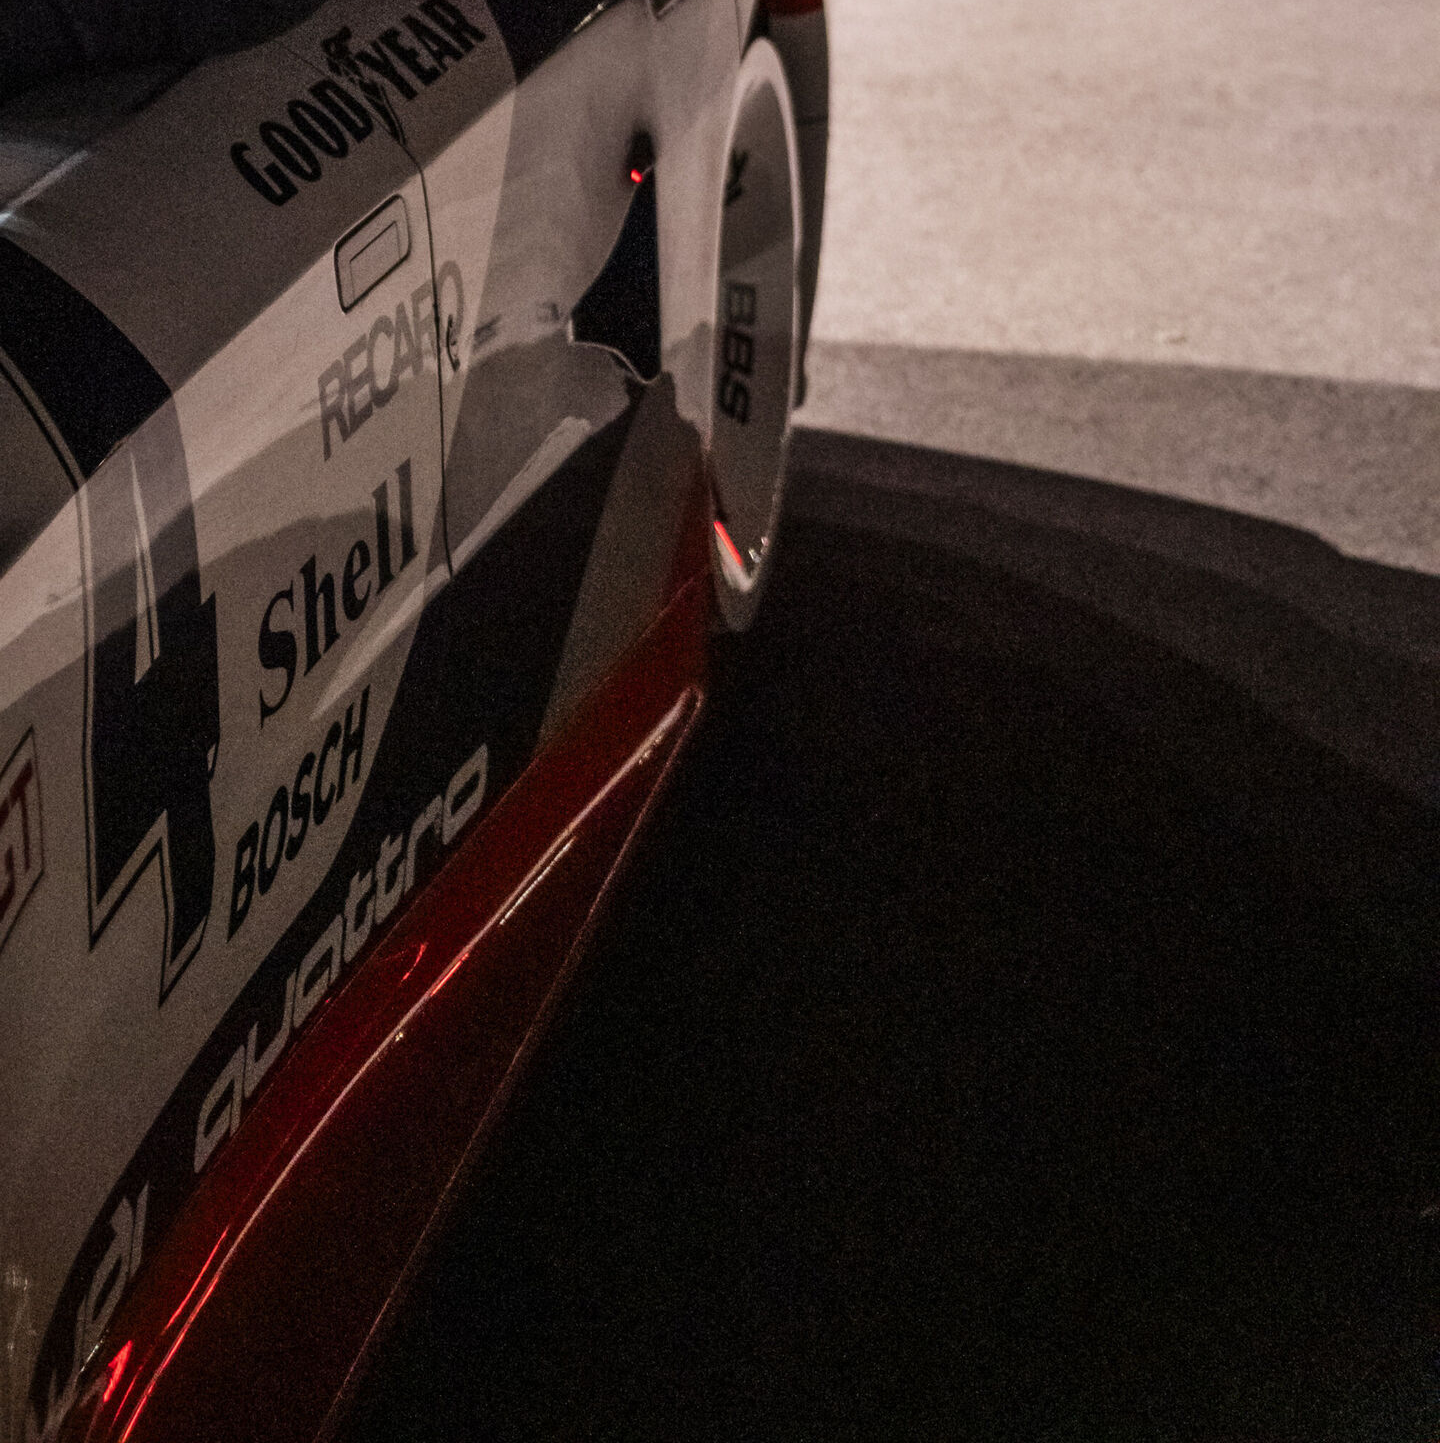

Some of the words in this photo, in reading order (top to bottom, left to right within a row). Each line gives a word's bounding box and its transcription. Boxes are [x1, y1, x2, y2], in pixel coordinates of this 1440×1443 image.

[317, 260, 464, 462] RECARO
[717, 281, 756, 424] BBS
[258, 457, 418, 730] Shell
[228, 683, 371, 944] BOSCH
[193, 742, 490, 1174] quattro
